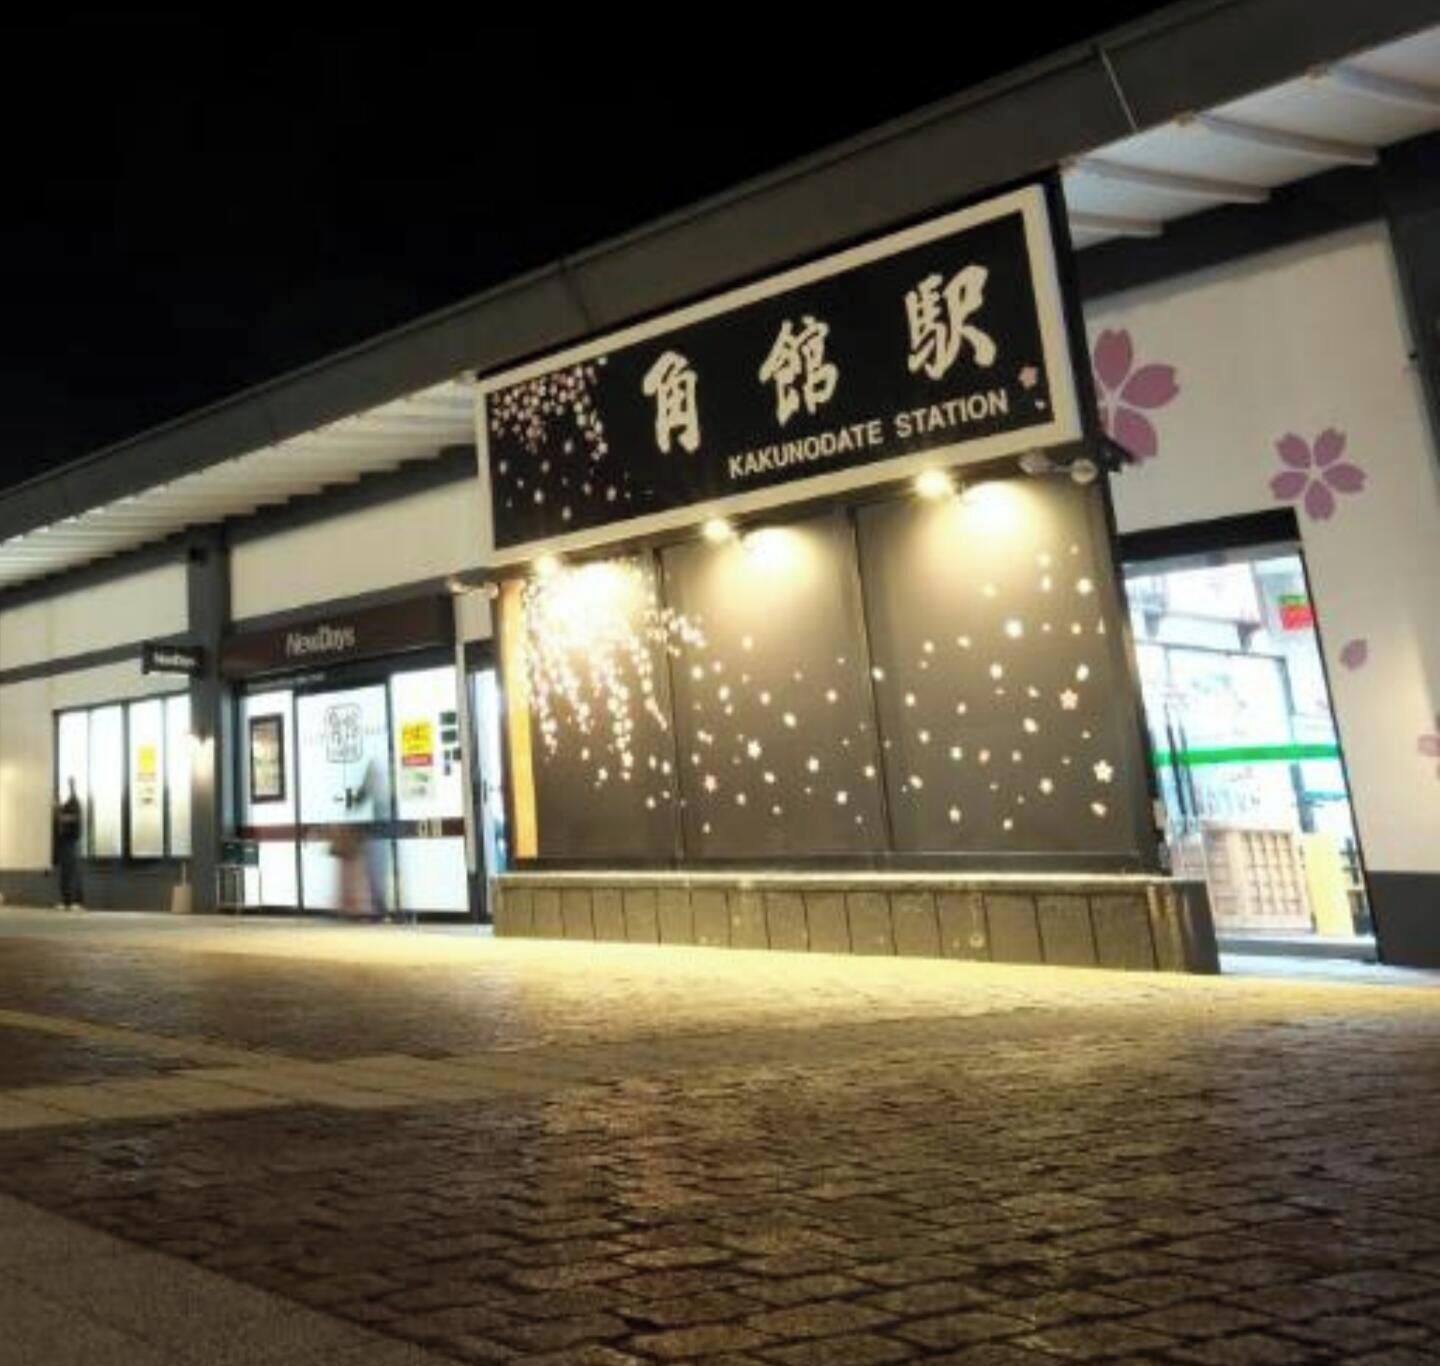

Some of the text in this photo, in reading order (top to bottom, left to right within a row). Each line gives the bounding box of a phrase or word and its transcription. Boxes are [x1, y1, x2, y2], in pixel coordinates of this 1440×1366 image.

[642, 264, 998, 455] 角館駅
[728, 388, 1009, 479] KAKUNODATE STATION
[286, 626, 355, 656] NewDays
